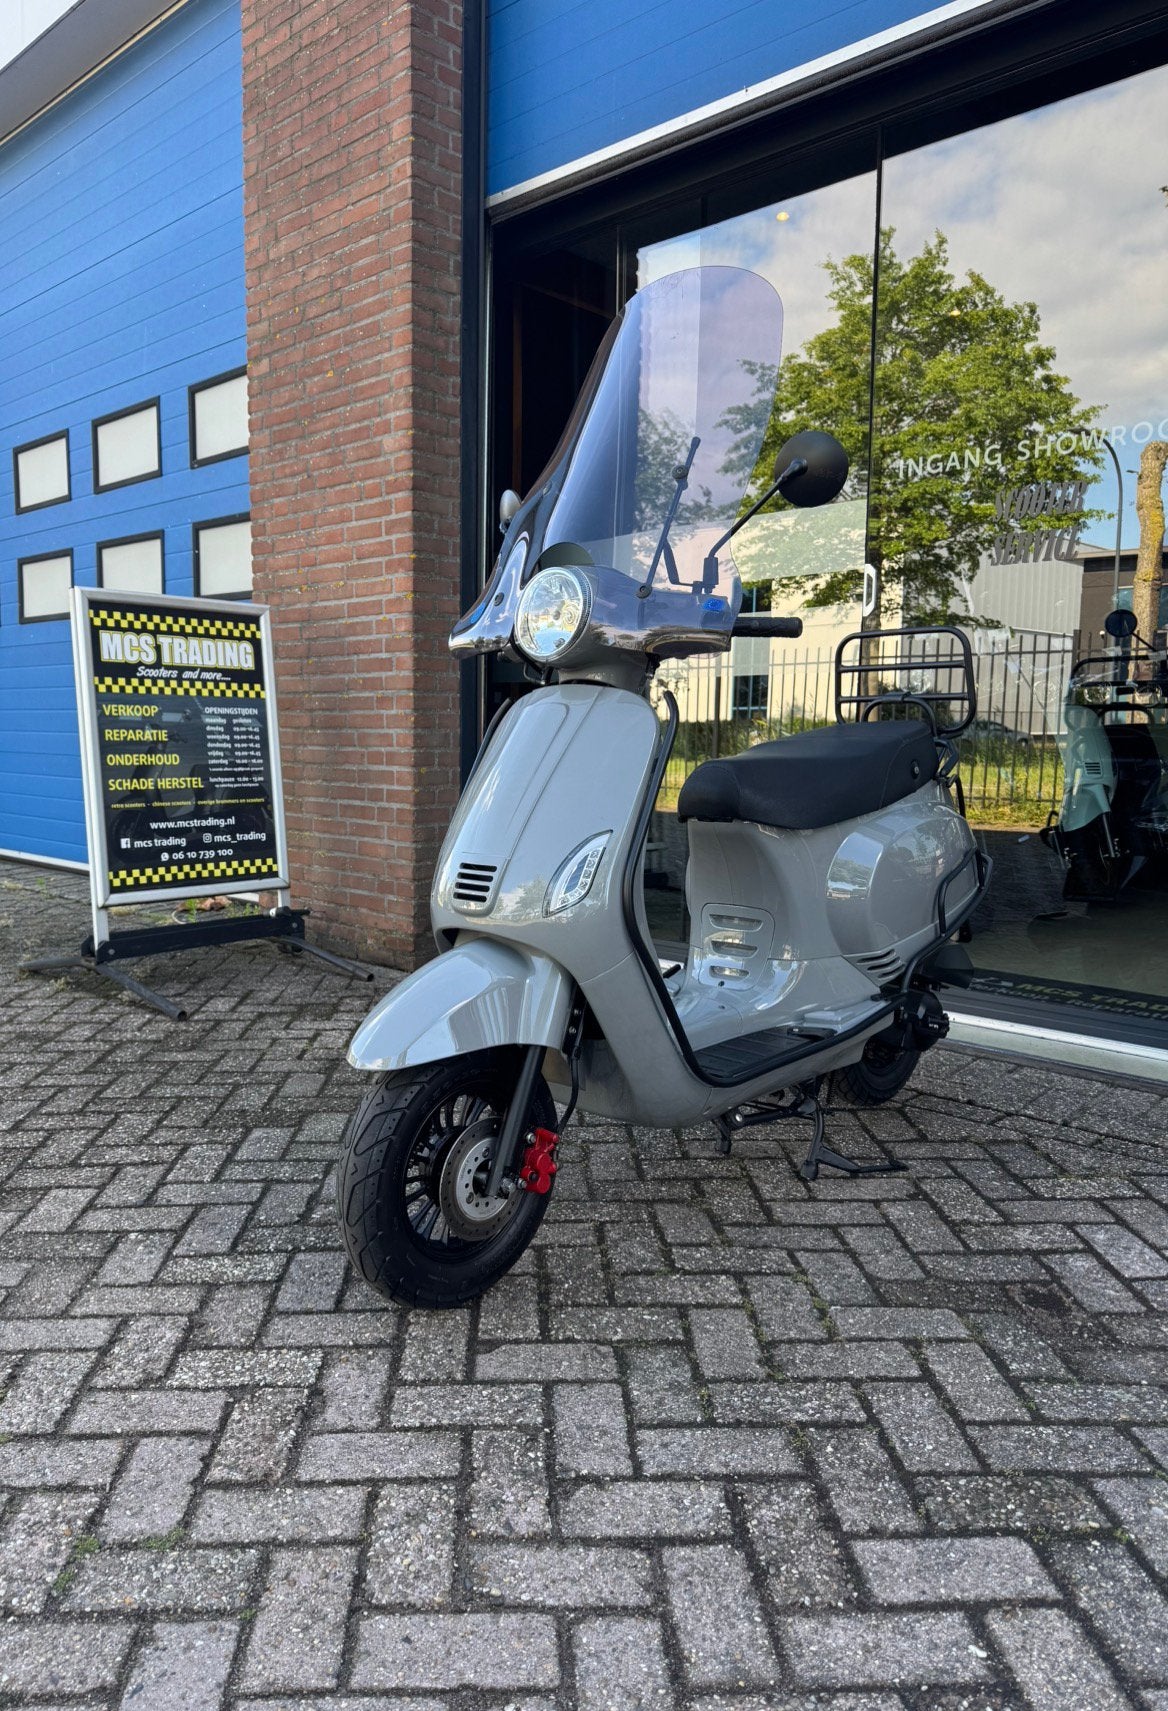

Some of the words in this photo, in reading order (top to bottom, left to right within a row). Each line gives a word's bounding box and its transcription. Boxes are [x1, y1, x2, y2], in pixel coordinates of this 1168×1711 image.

[899, 444, 1002, 480] INGANG
[993, 480, 1088, 522] SCOOTER
[990, 526, 1081, 566] SERVICE
[100, 630, 157, 664] MCS
[157, 635, 254, 670] TRADING
[136, 666, 178, 678] Scooters
[182, 668, 198, 679] and
[103, 704, 159, 717] VERKOOP
[204, 706, 258, 716] OPENINGSTIJDEN
[104, 729, 168, 741] REPARATIE
[106, 754, 180, 766] ONDERHOUD
[108, 778, 155, 791] SCHADE
[157, 777, 204, 789] HERSTEL
[150, 816, 235, 829] www.mcstrading.nl
[154, 838, 186, 848] trading
[214, 831, 266, 843] mcs_trading
[172, 851, 185, 860] 06
[186, 851, 197, 859] 10
[199, 850, 215, 859] 739
[218, 848, 233, 857] 100
[1016, 983, 1082, 997] MCS
